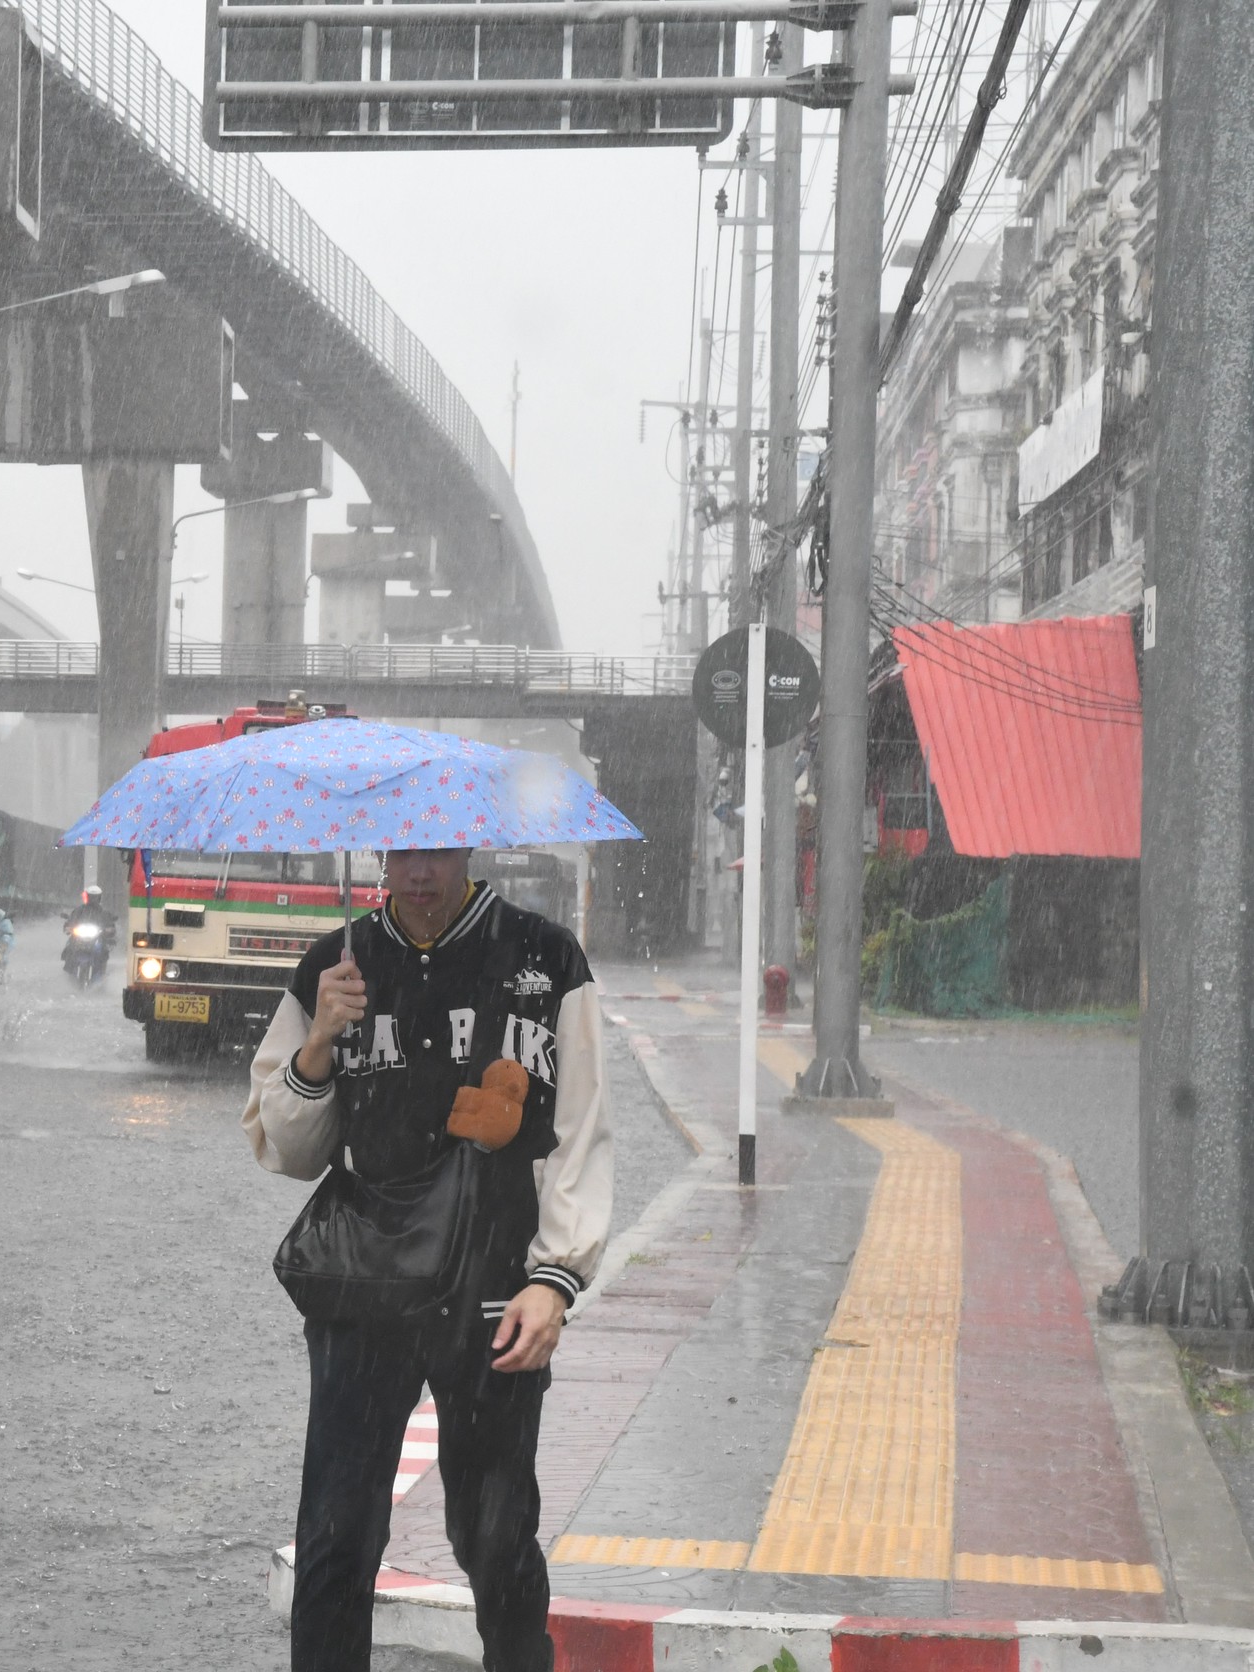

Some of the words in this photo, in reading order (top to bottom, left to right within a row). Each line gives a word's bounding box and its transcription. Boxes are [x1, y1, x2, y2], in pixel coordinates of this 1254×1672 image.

[1147, 604, 1152, 634] 8
[241, 937, 312, 951] ISUZ
[160, 1000, 206, 1015] 11-9753
